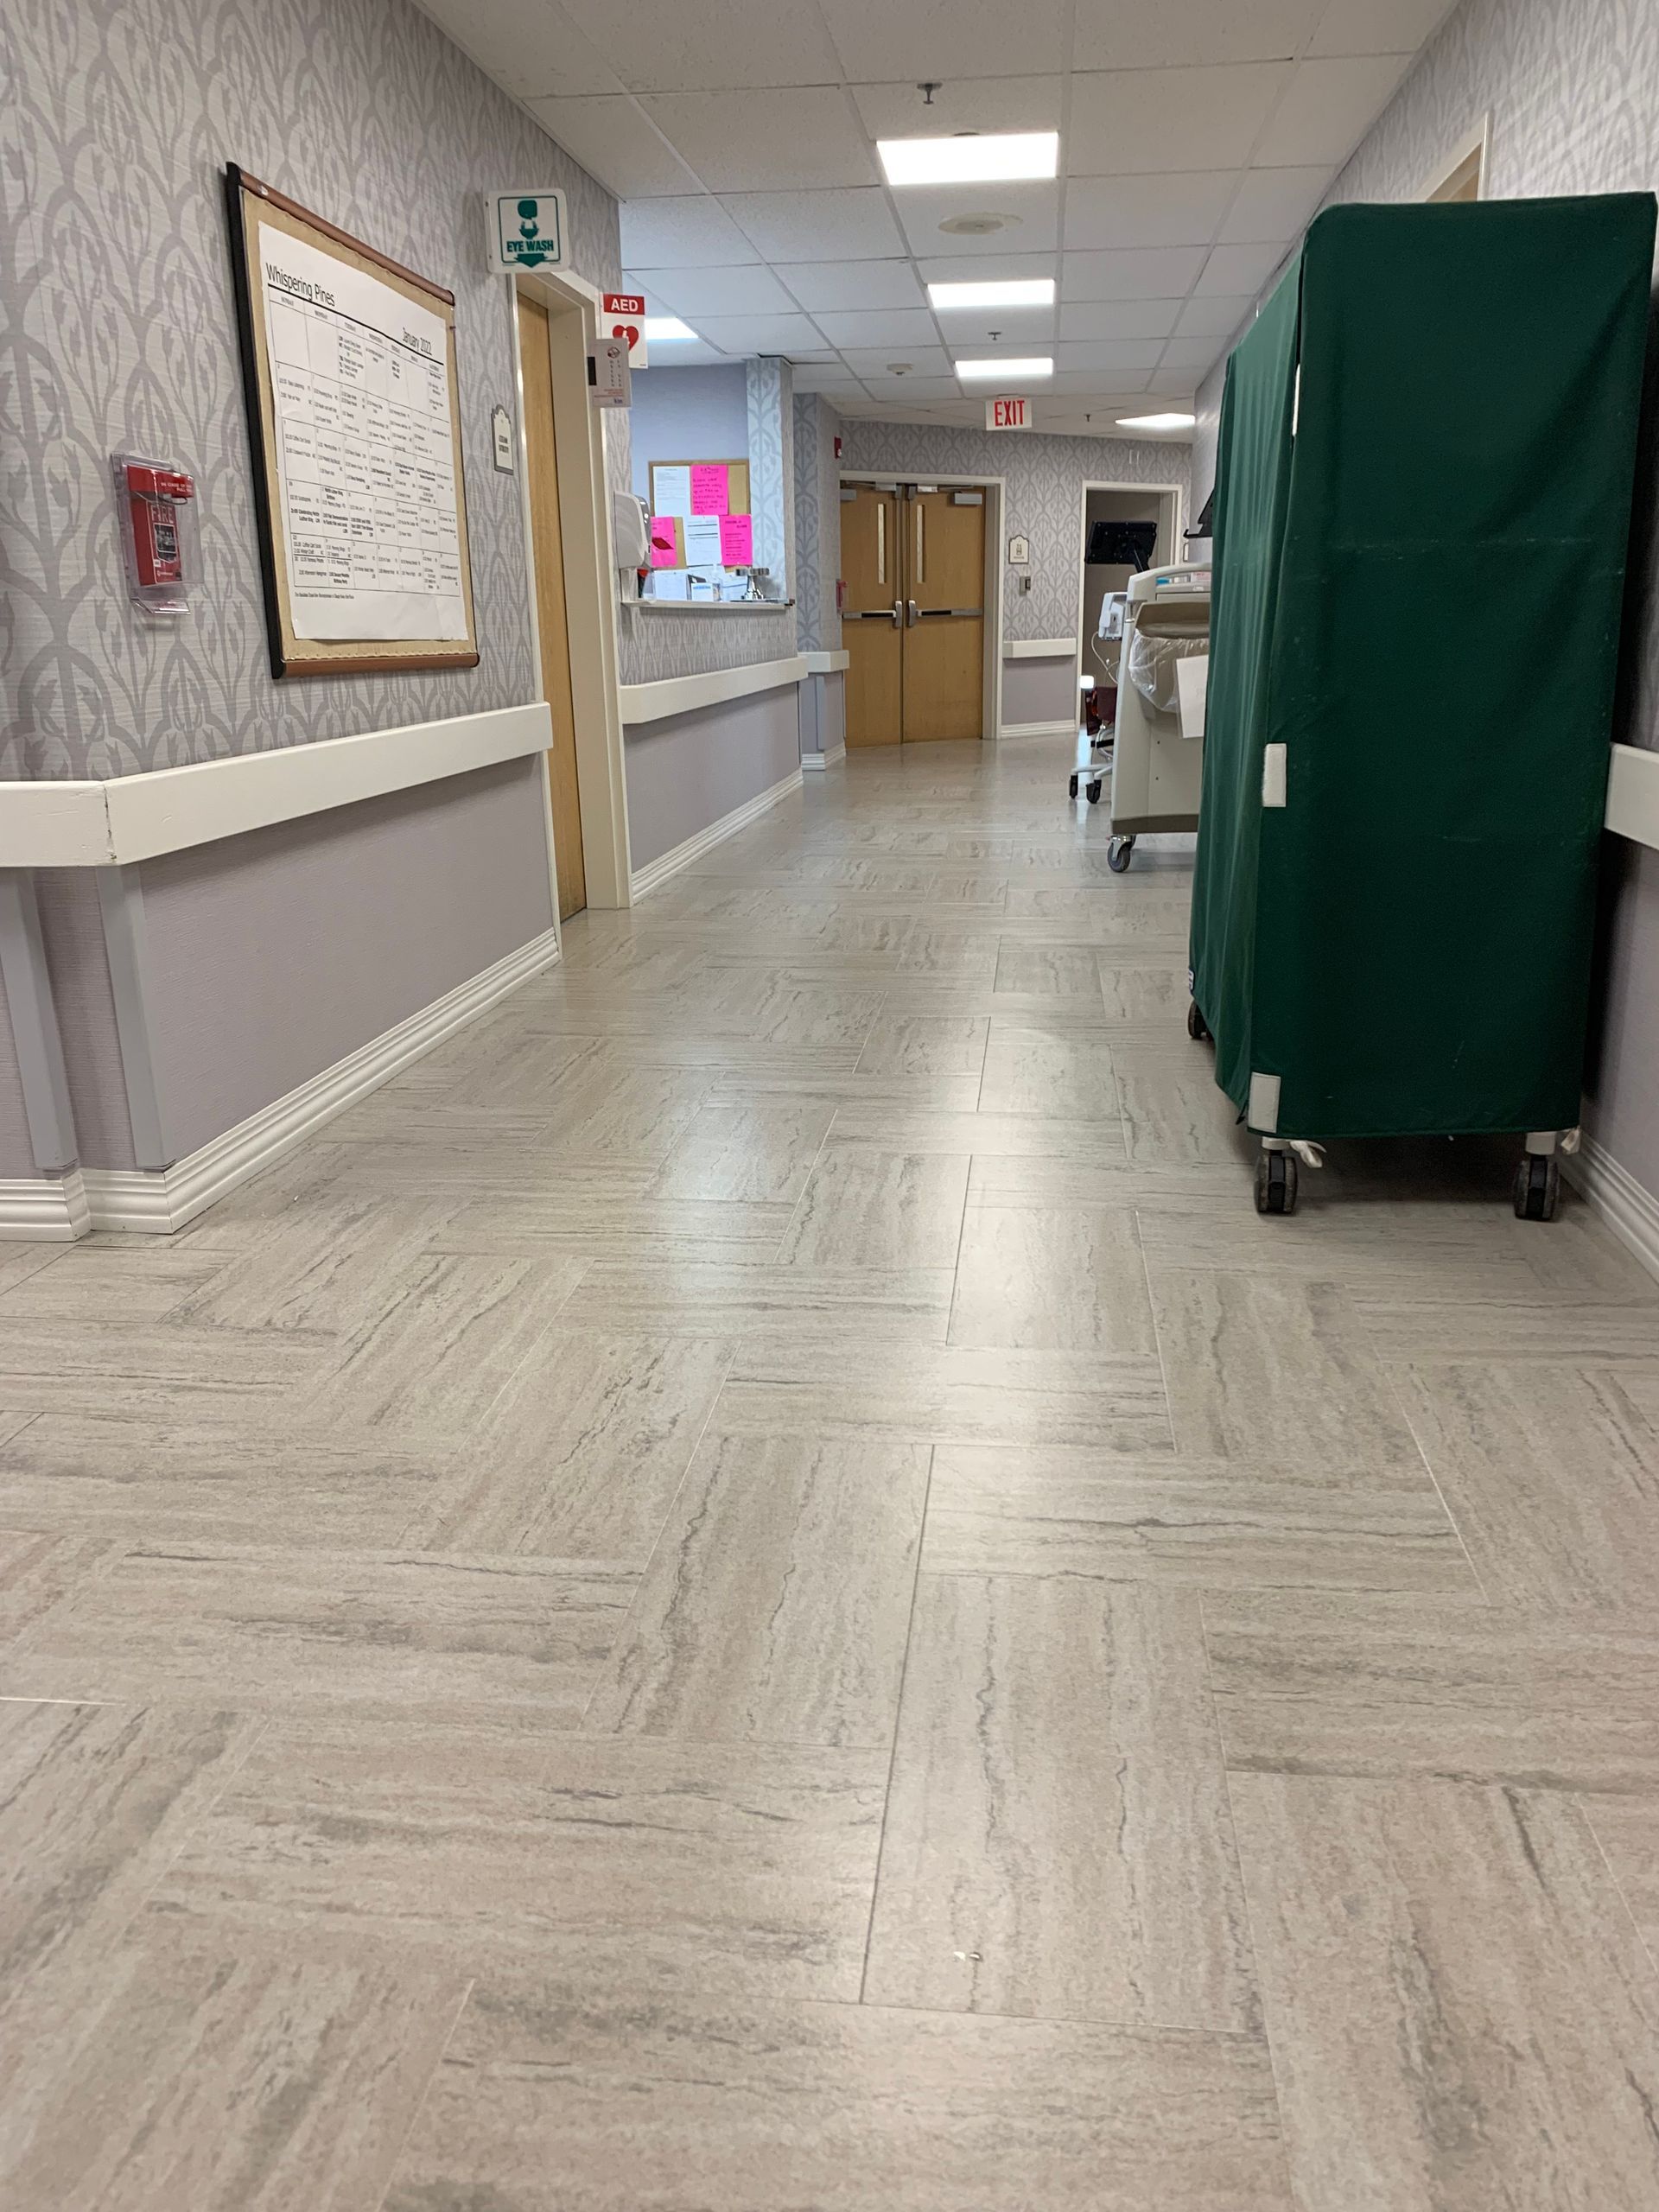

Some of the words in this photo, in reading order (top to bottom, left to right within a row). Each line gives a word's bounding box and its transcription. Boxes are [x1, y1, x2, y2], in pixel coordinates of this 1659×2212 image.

[506, 241, 524, 252] EYE
[525, 239, 554, 252] WASH
[265, 262, 313, 302] Whispering
[315, 283, 335, 307] Pines
[611, 298, 639, 312] AED
[403, 327, 420, 352] January
[995, 400, 1025, 426] EXIT
[152, 505, 175, 524] FIRE
